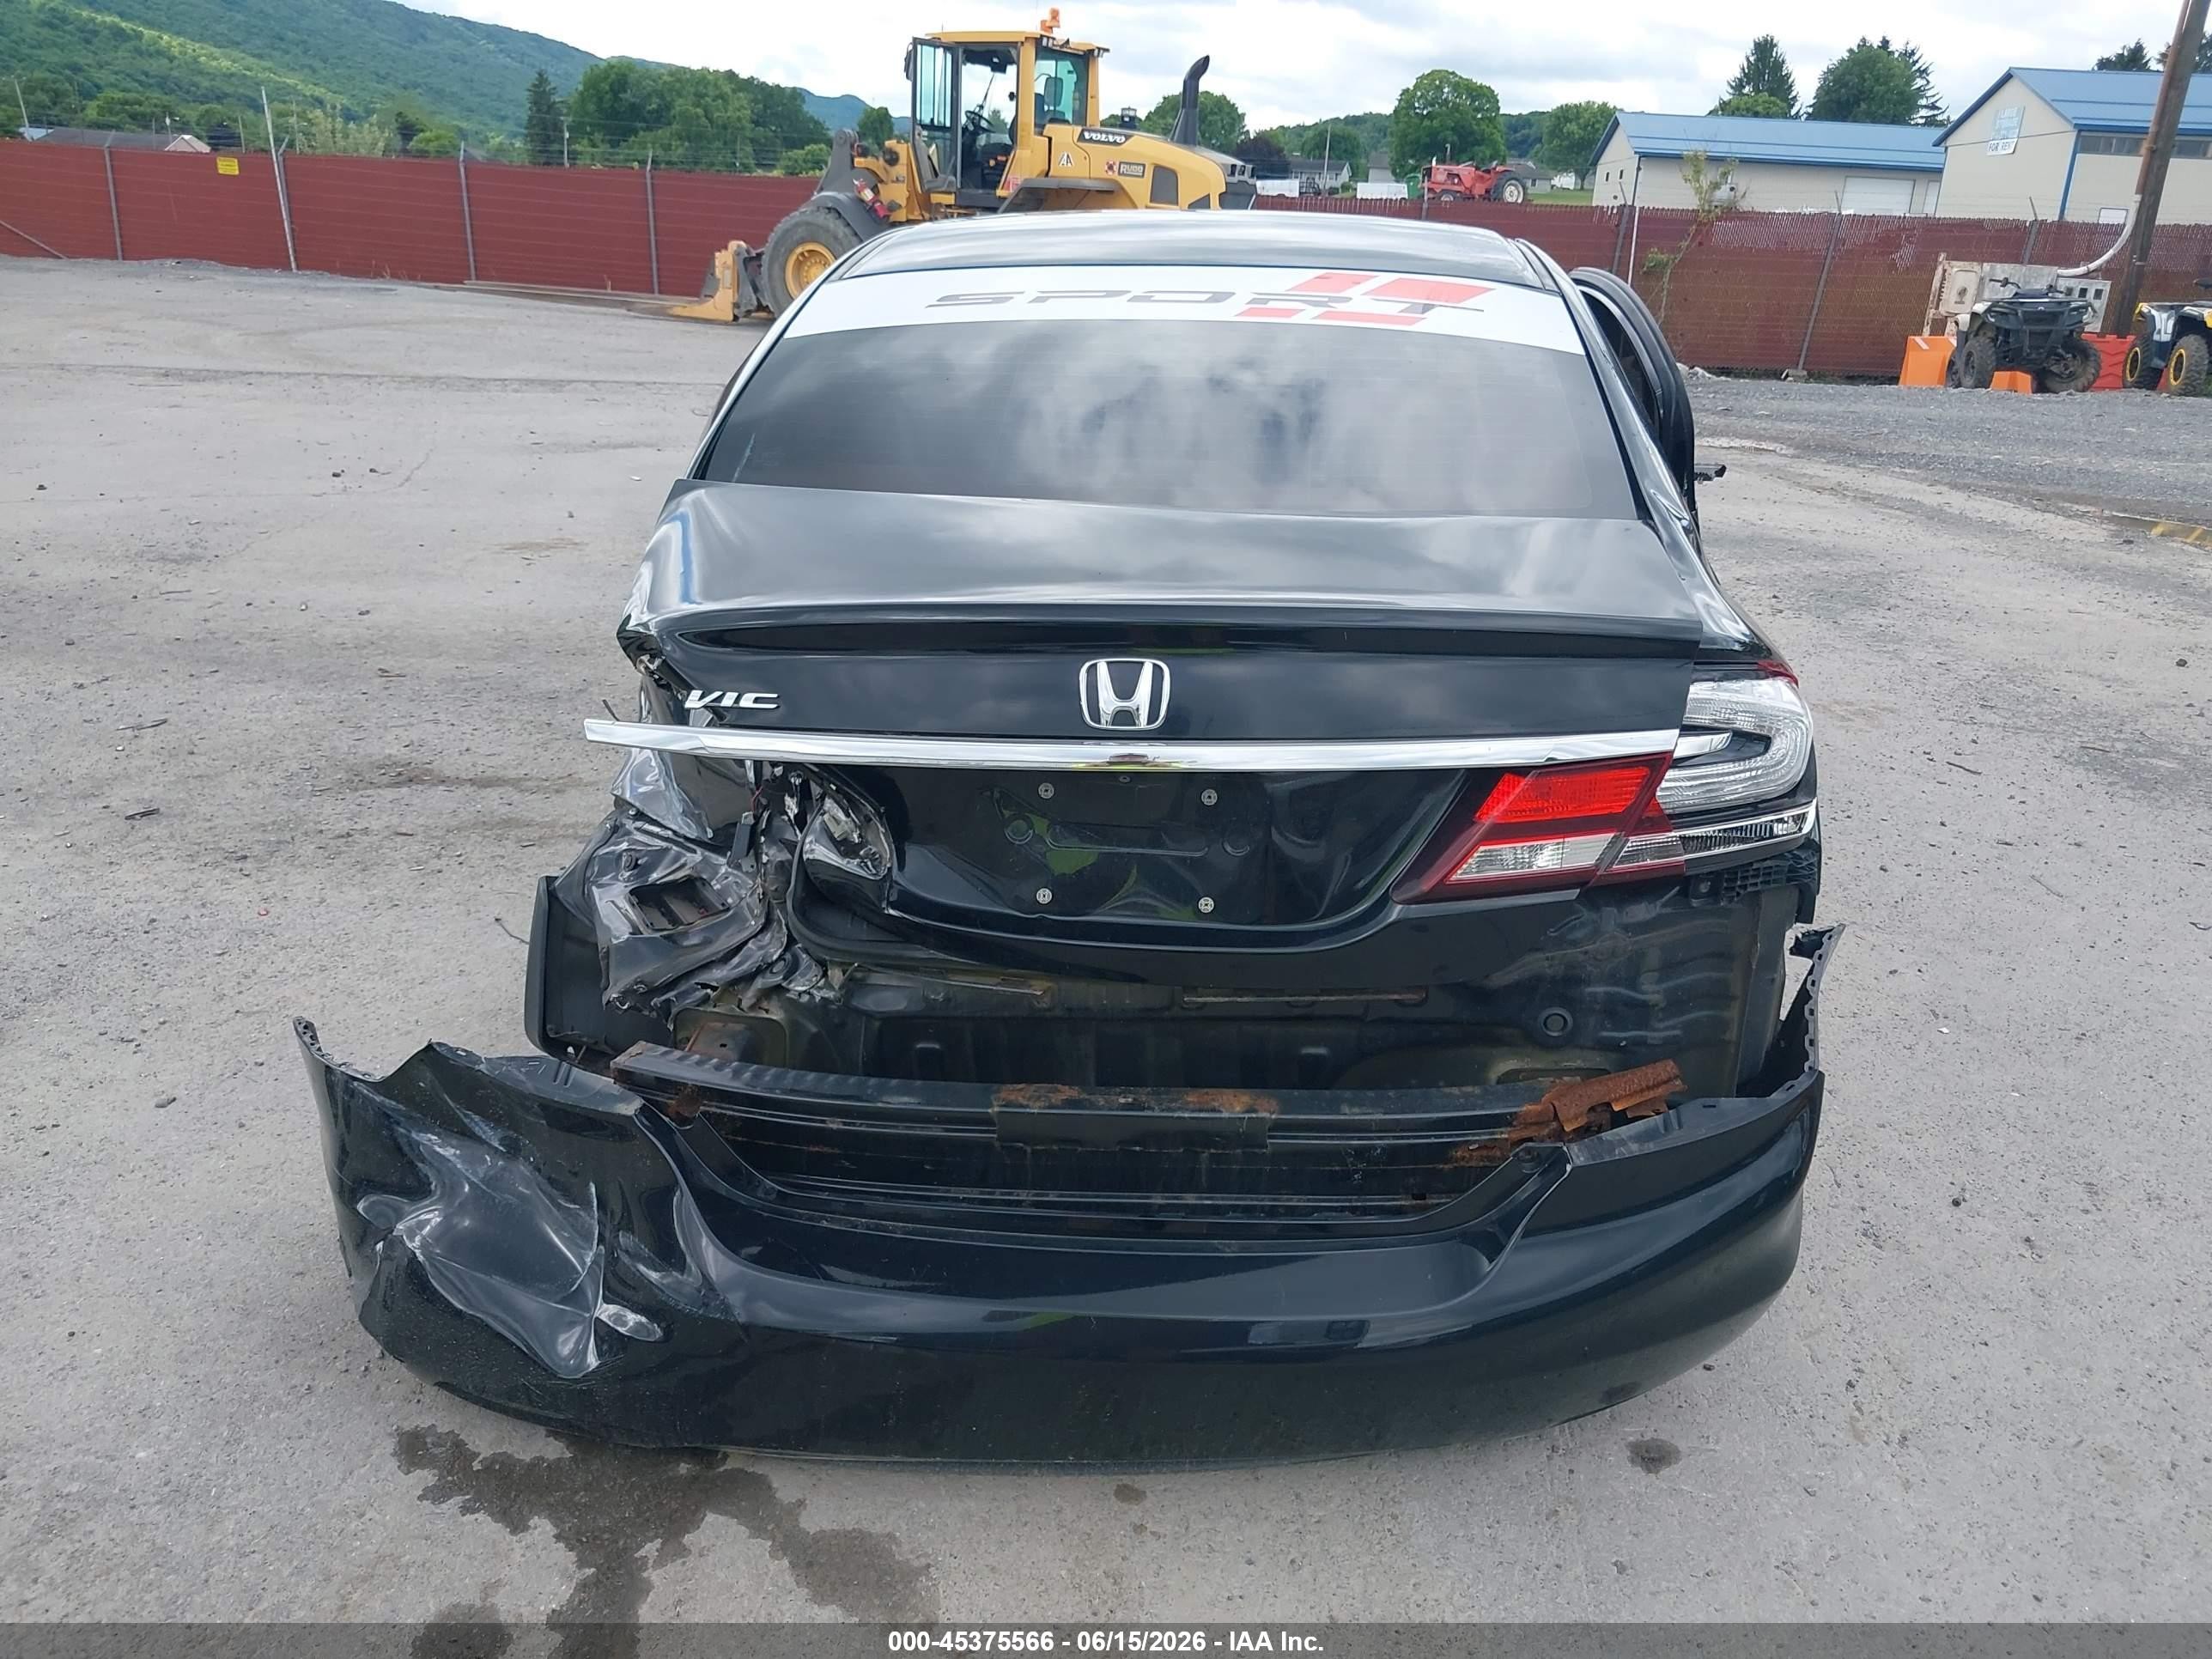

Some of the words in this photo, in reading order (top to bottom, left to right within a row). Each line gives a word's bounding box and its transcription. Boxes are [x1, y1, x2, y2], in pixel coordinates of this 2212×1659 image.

[1084, 131, 1126, 143] VOLVO
[1988, 142, 1999, 152] FOR
[926, 289, 1484, 314] SPORT
[684, 690, 779, 708] VIC
